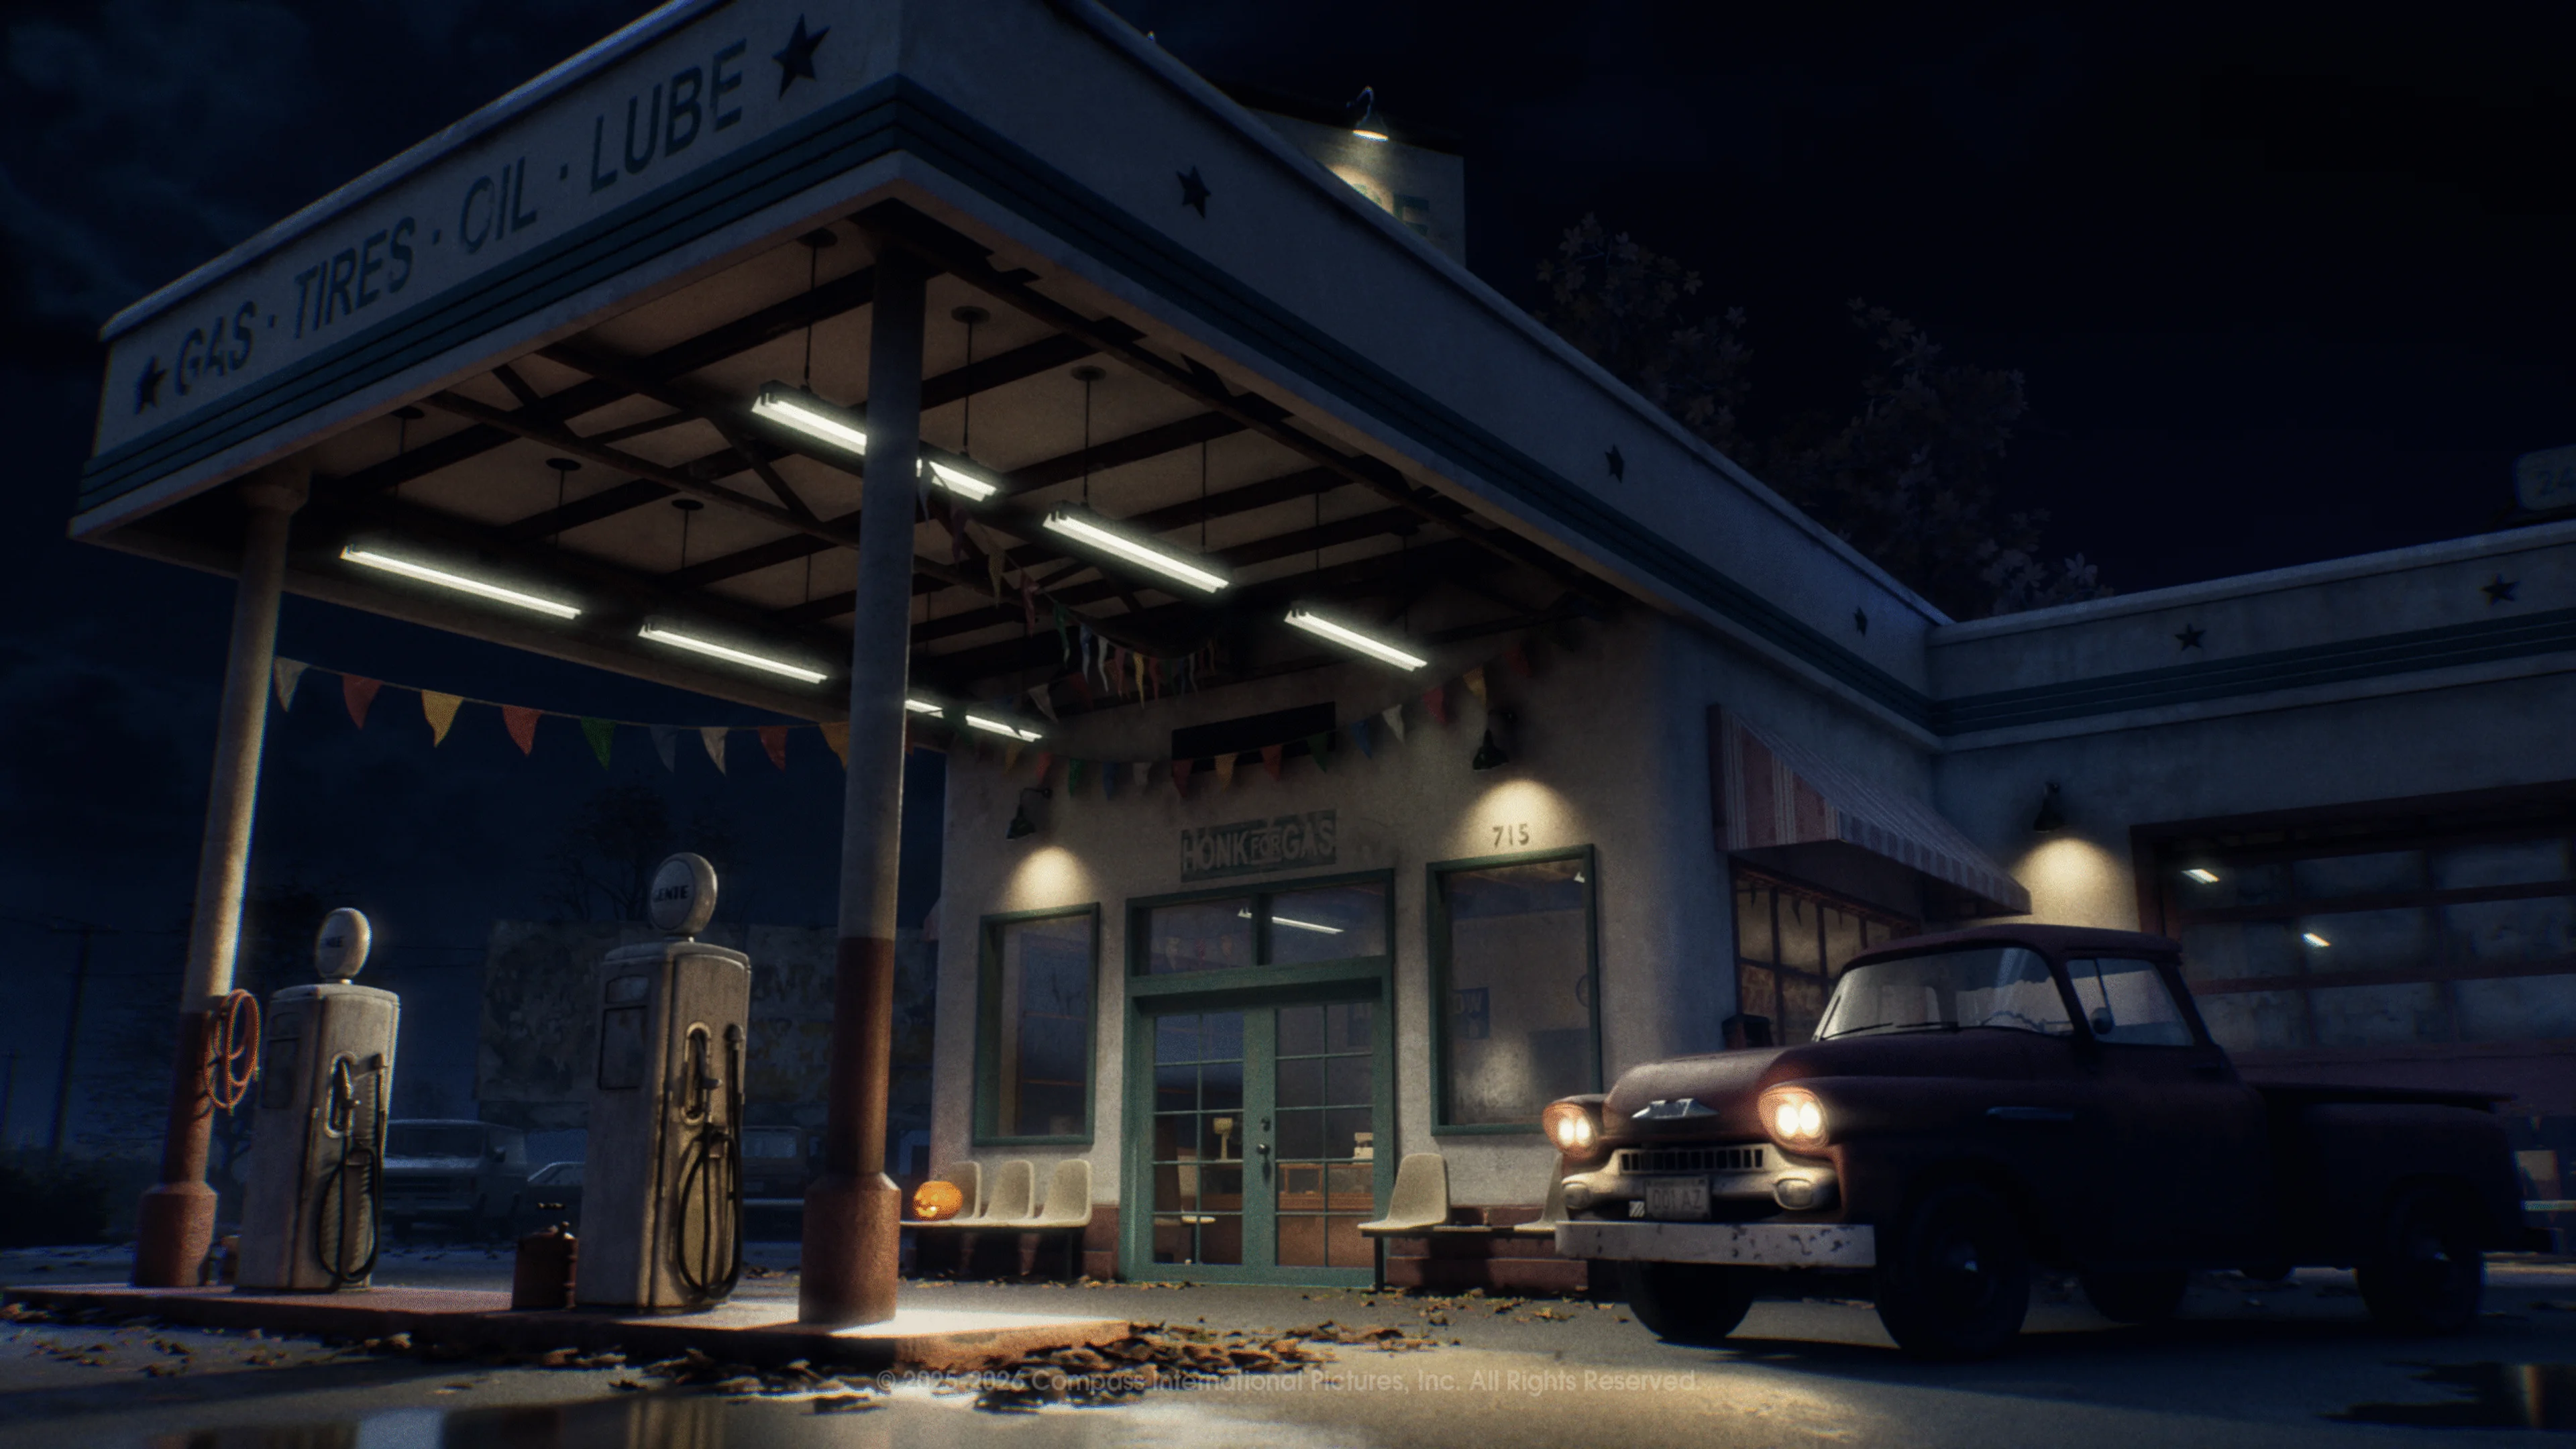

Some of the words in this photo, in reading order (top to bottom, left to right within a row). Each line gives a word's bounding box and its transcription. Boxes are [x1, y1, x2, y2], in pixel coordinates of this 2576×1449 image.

[173, 301, 256, 396] GAS
[293, 216, 416, 339] TIRES
[460, 156, 536, 255] OIL
[590, 38, 747, 194] LUBE
[1183, 830, 1250, 873] HONK
[1250, 833, 1282, 859] FOR
[1282, 819, 1334, 860] GAS
[1492, 823, 1529, 848] 715
